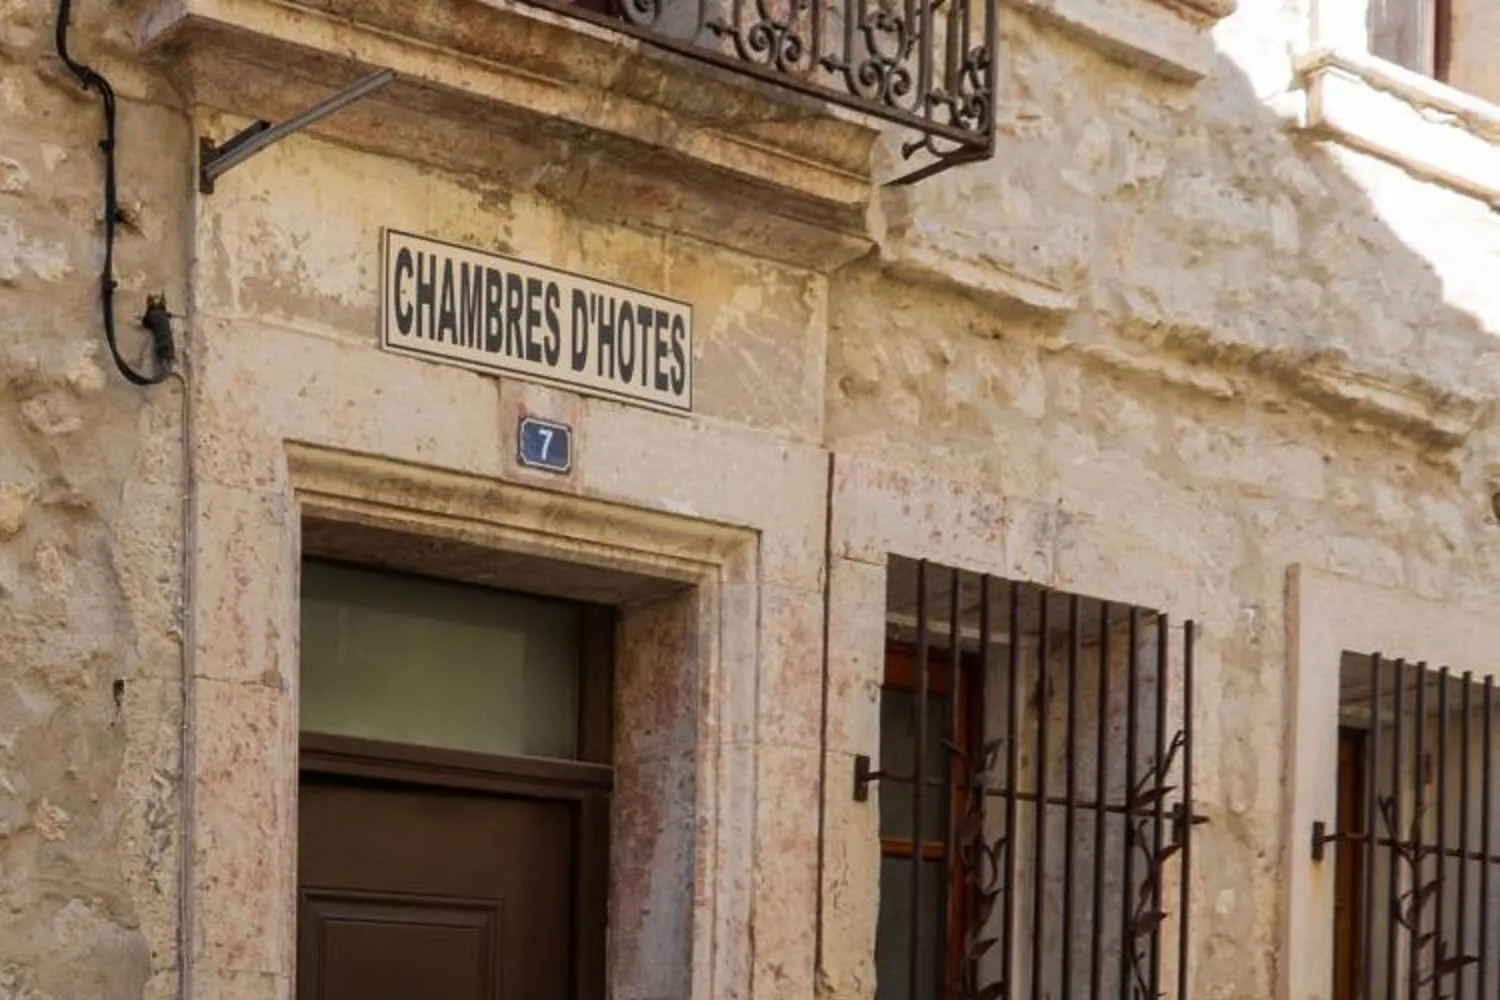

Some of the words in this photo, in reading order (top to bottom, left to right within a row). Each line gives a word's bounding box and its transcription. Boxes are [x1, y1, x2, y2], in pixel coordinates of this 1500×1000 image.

[394, 246, 560, 367] CHAMBRES
[571, 288, 686, 396] D'HOTES
[537, 429, 554, 461] 7
